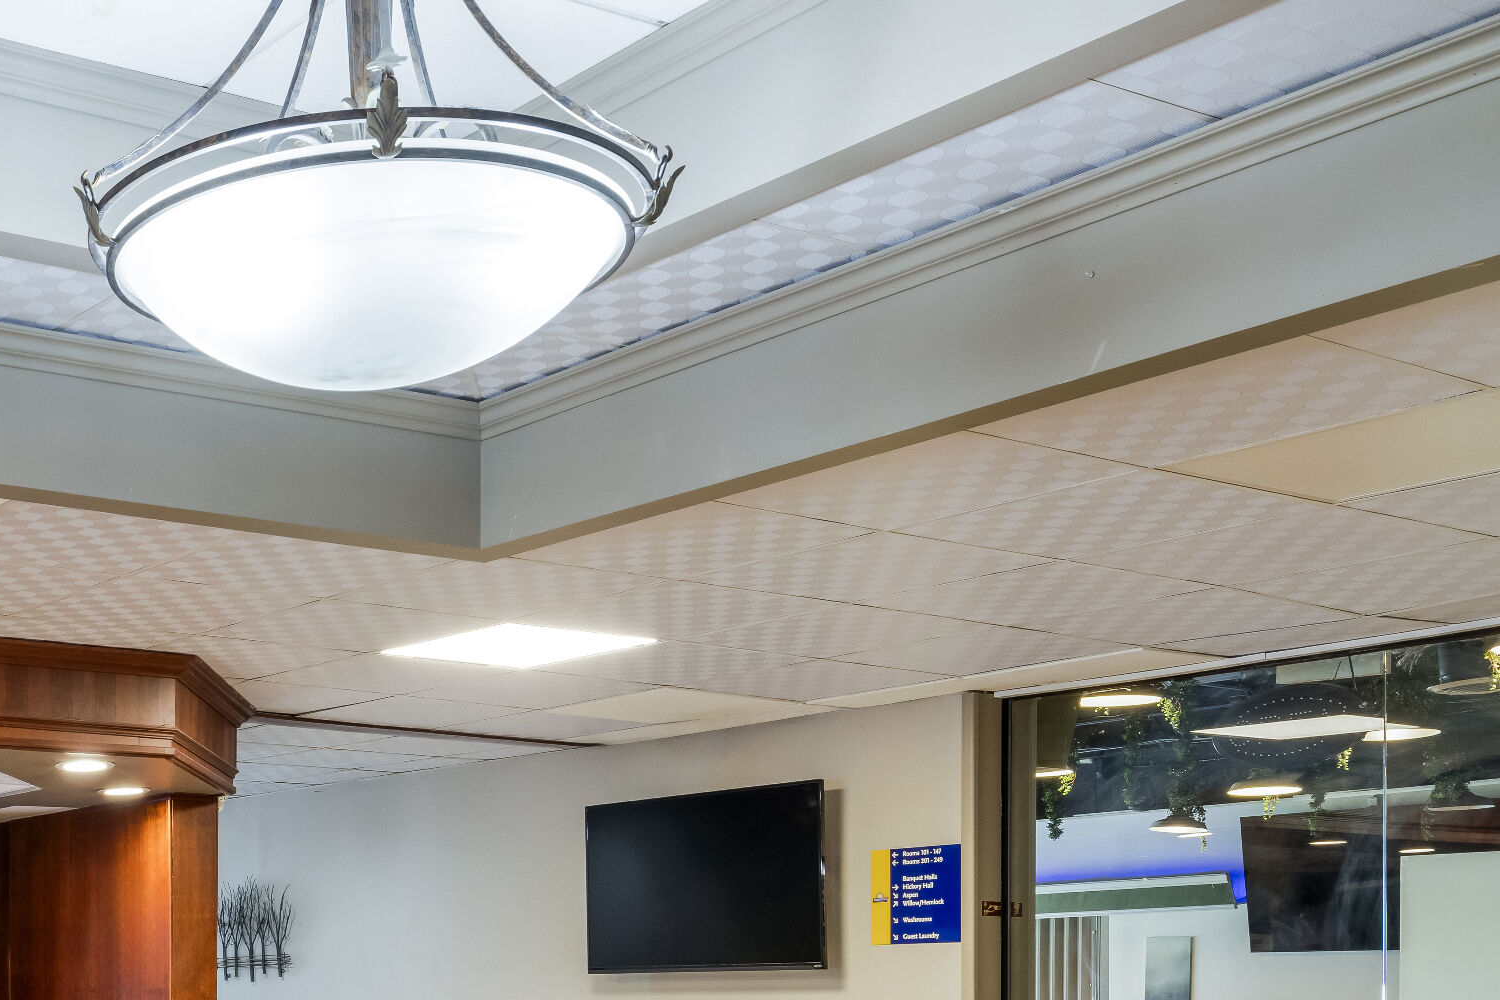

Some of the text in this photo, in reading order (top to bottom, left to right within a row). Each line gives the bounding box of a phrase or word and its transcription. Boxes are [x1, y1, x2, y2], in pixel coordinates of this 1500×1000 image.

[902, 858, 920, 866] Rooms
[902, 873, 938, 883] Banquet Halls
[902, 881, 934, 891] Hickory Hall
[918, 931, 940, 940] Laundry
